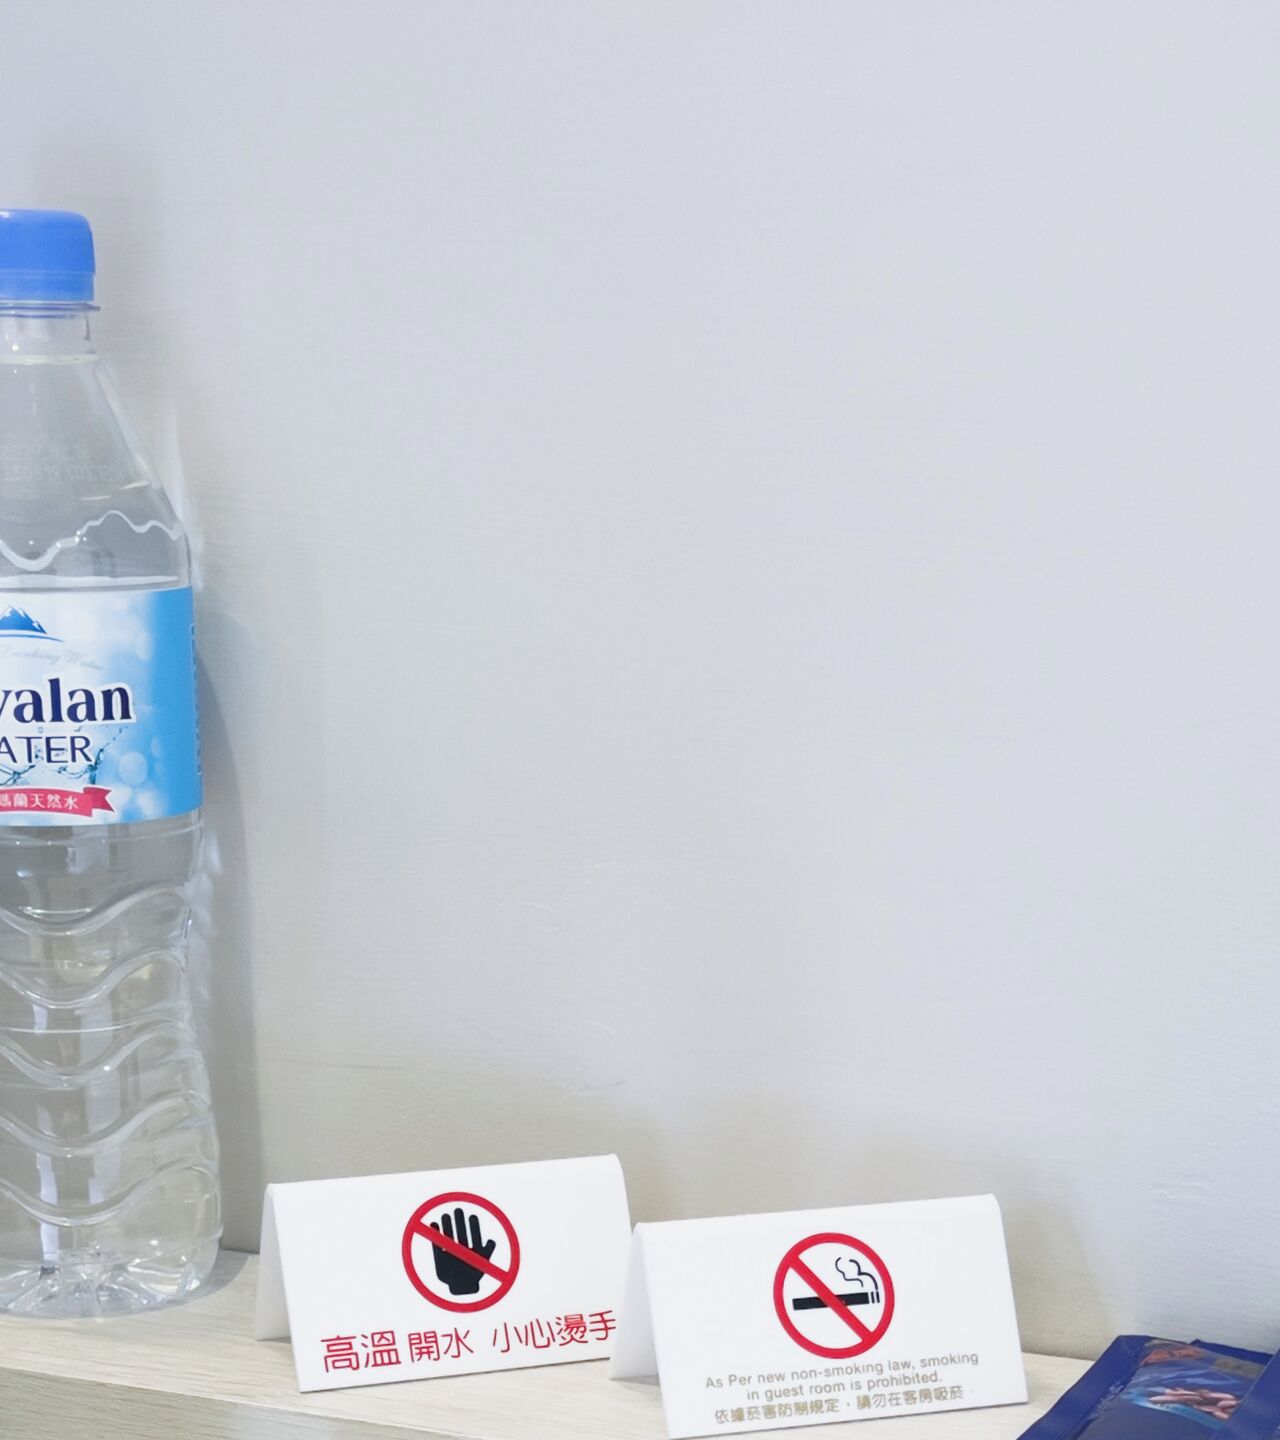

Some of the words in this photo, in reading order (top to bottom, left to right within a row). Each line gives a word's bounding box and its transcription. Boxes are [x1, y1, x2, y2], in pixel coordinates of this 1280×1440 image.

[321, 1331, 401, 1373] 高溫
[408, 1327, 475, 1364] 開水
[492, 1310, 617, 1353] 小心燙手
[705, 1376, 724, 1389] As
[728, 1373, 753, 1387] Per
[757, 1371, 786, 1383] new
[791, 1362, 884, 1381] non-smoking
[887, 1359, 916, 1372] law,
[919, 1352, 979, 1369] smoking
[746, 1387, 760, 1401] in
[764, 1384, 804, 1402] guest
[809, 1380, 846, 1395] room
[850, 1379, 862, 1391] is
[866, 1370, 943, 1392] prohibited.
